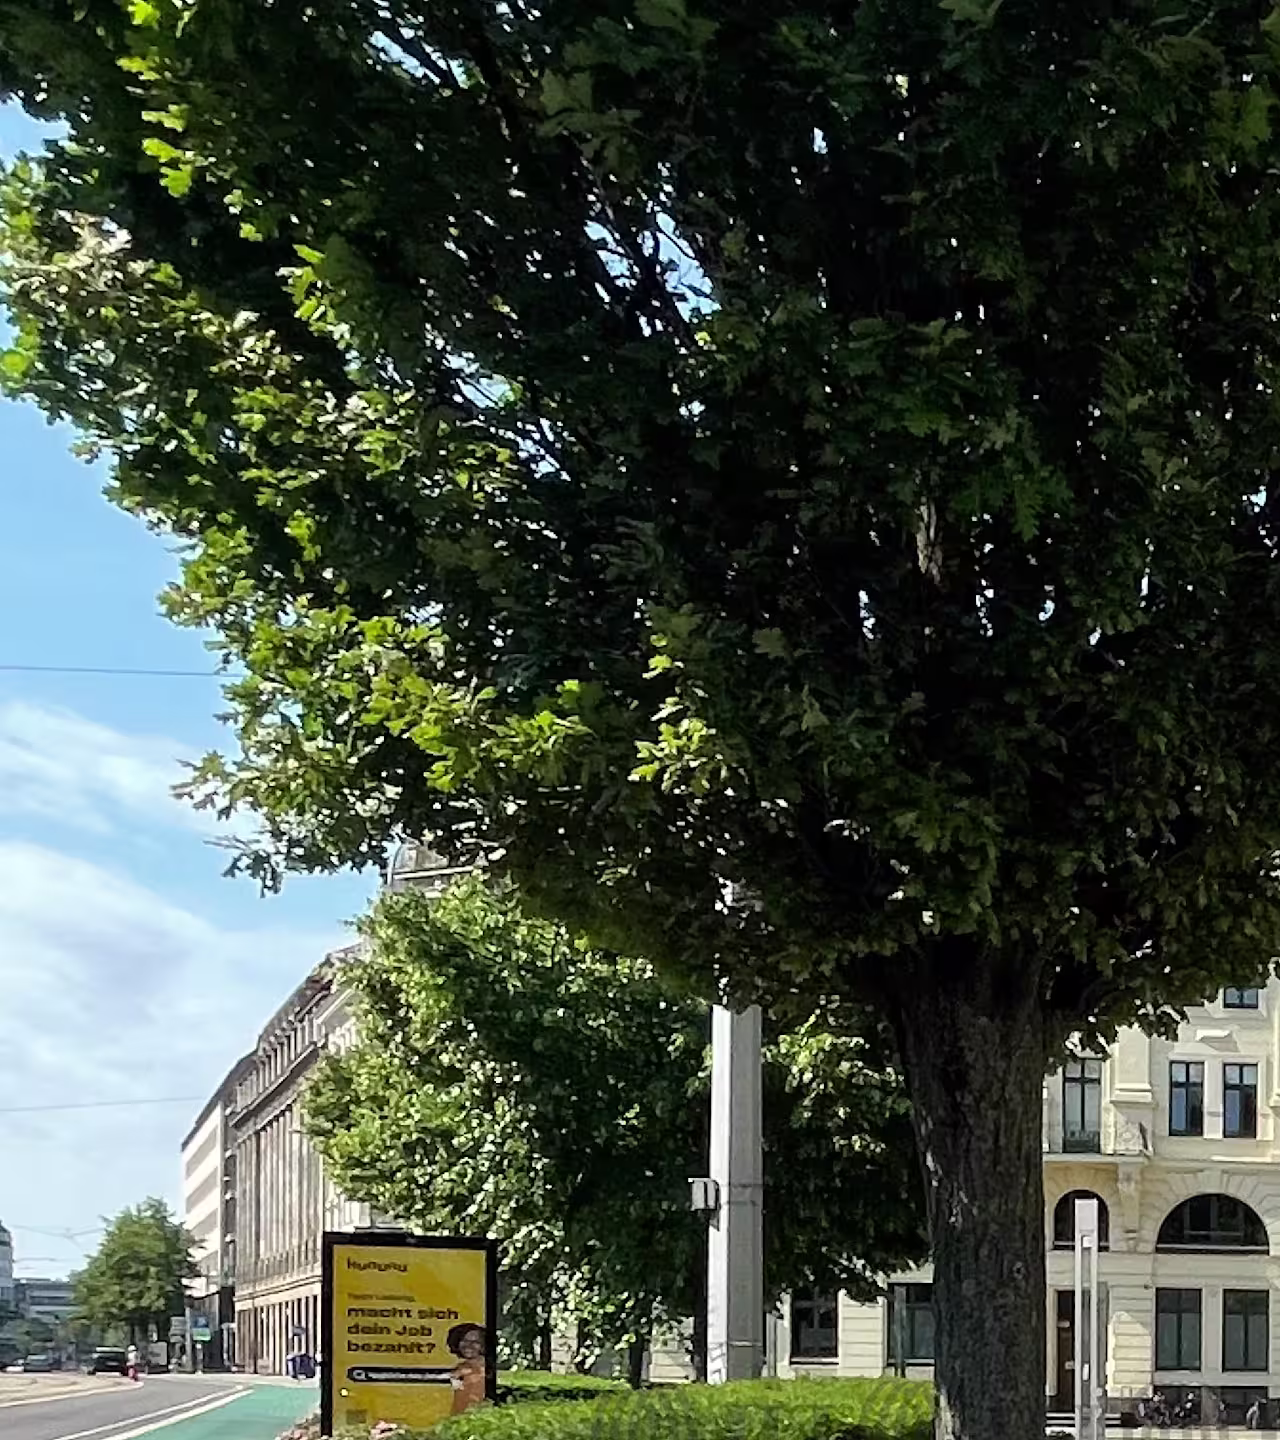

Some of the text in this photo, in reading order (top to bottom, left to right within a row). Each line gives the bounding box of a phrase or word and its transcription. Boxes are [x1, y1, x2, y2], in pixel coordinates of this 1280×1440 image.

[347, 1308, 459, 1320] macht sich
[347, 1324, 433, 1337] dein Job
[347, 1340, 436, 1353] bezahlt?
